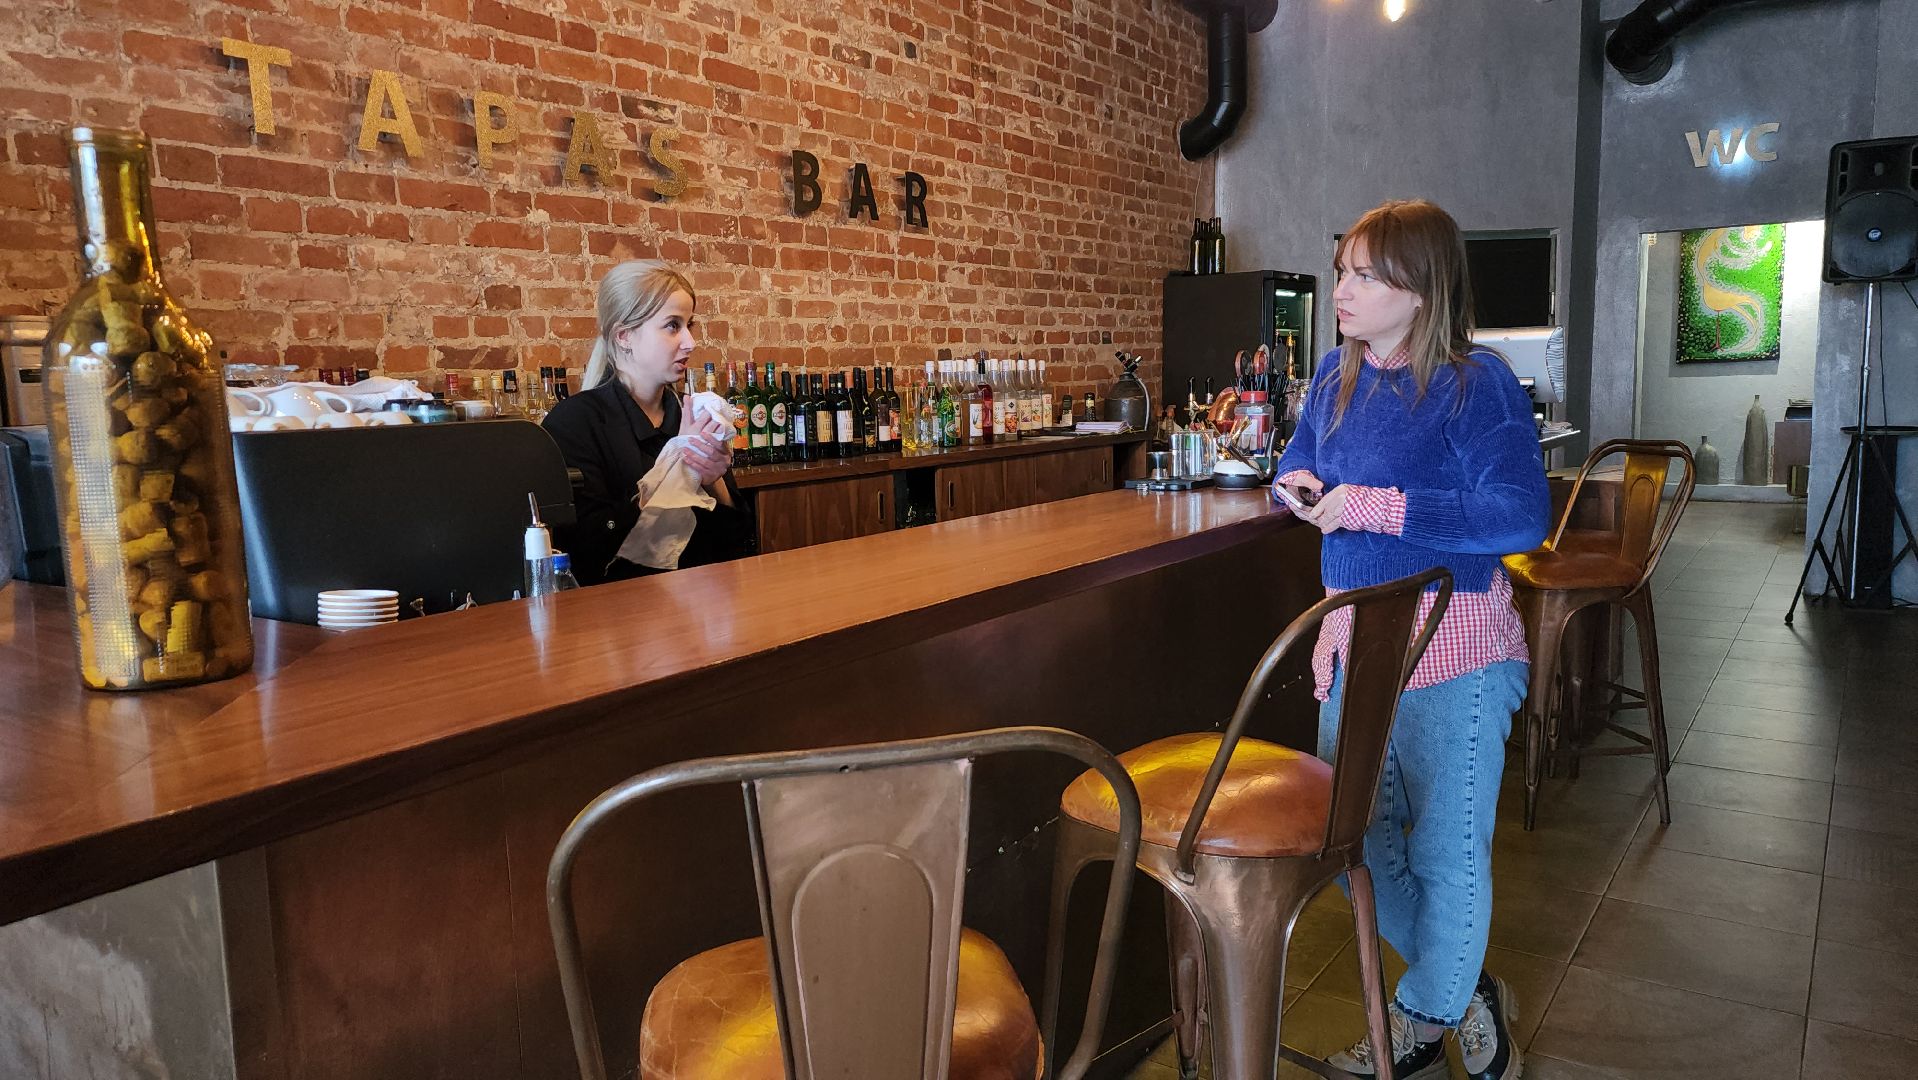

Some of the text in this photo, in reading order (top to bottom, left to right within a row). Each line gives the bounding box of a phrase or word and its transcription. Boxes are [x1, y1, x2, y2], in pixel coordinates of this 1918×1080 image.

[222, 37, 929, 228] TAPAS BAR
[1685, 122, 1780, 168] WC
